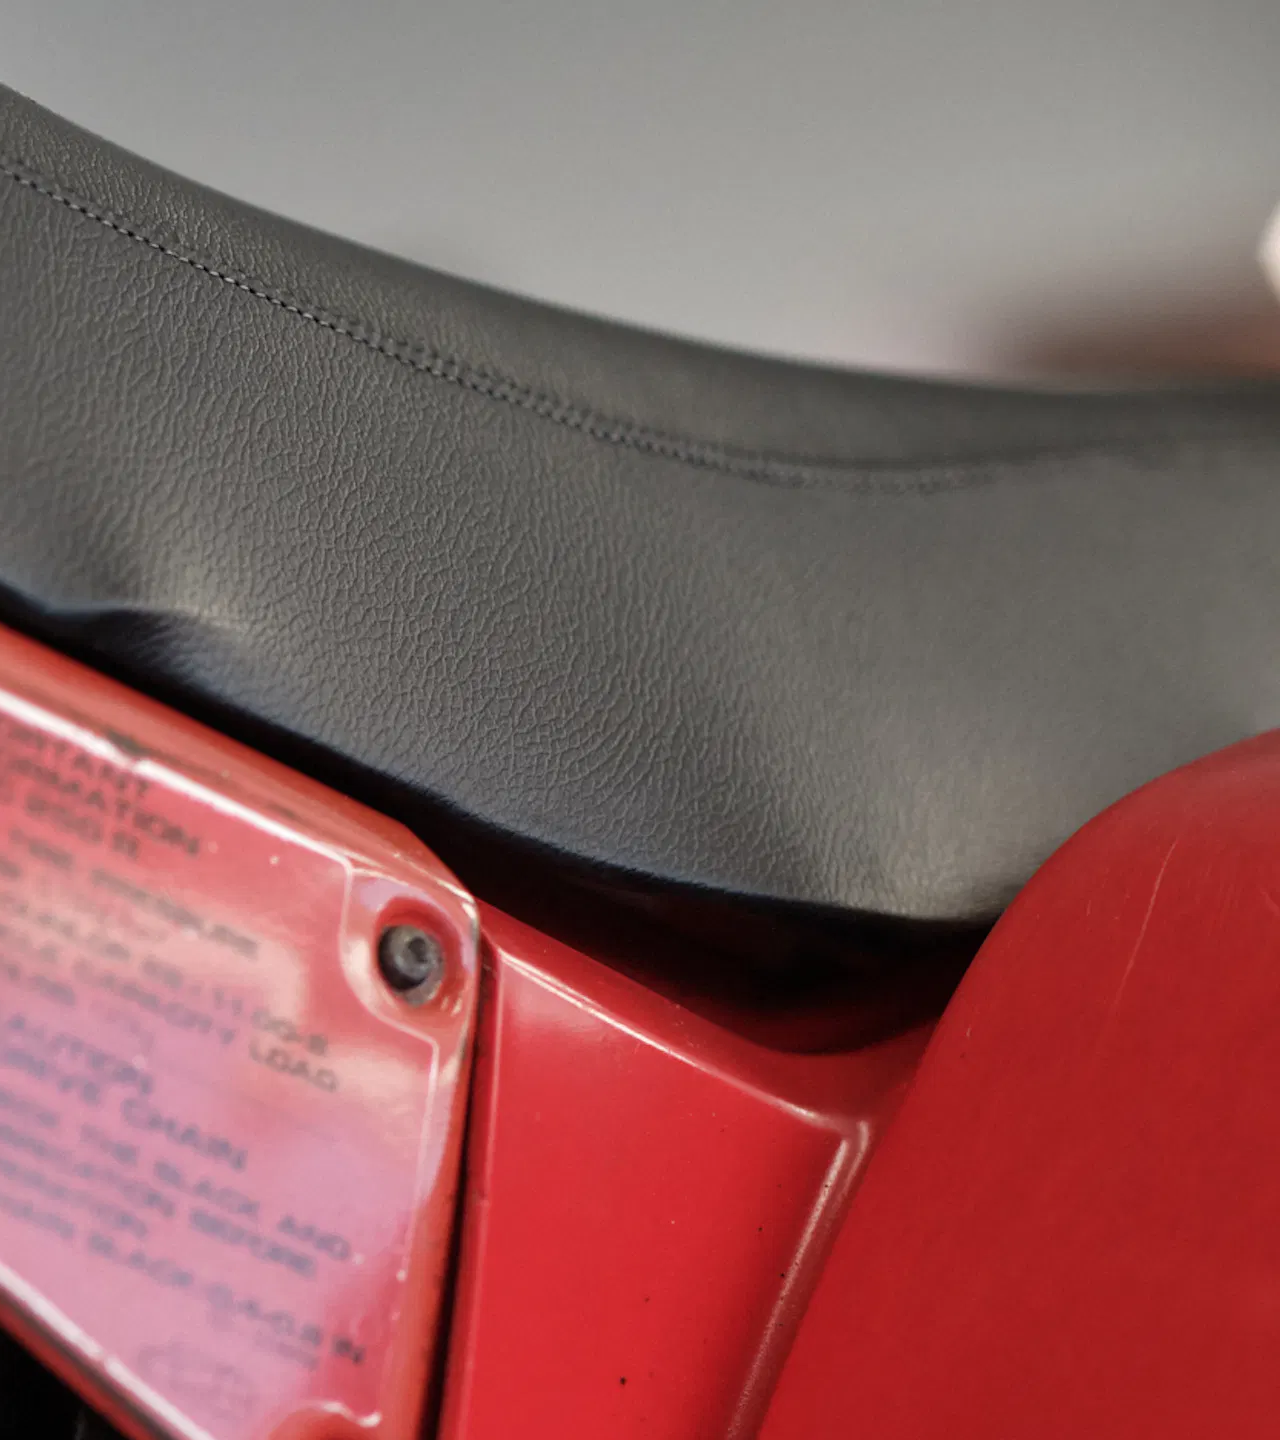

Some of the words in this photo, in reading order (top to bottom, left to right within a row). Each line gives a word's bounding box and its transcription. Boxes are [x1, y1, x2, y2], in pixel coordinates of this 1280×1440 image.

[90, 866, 260, 957] PRESSURE
[74, 957, 236, 1047] CAPACITY
[249, 1034, 338, 1093] LOAD
[120, 1097, 249, 1173] CHAIN
[188, 1206, 318, 1279] BEFORE
[277, 1214, 352, 1263] AND
